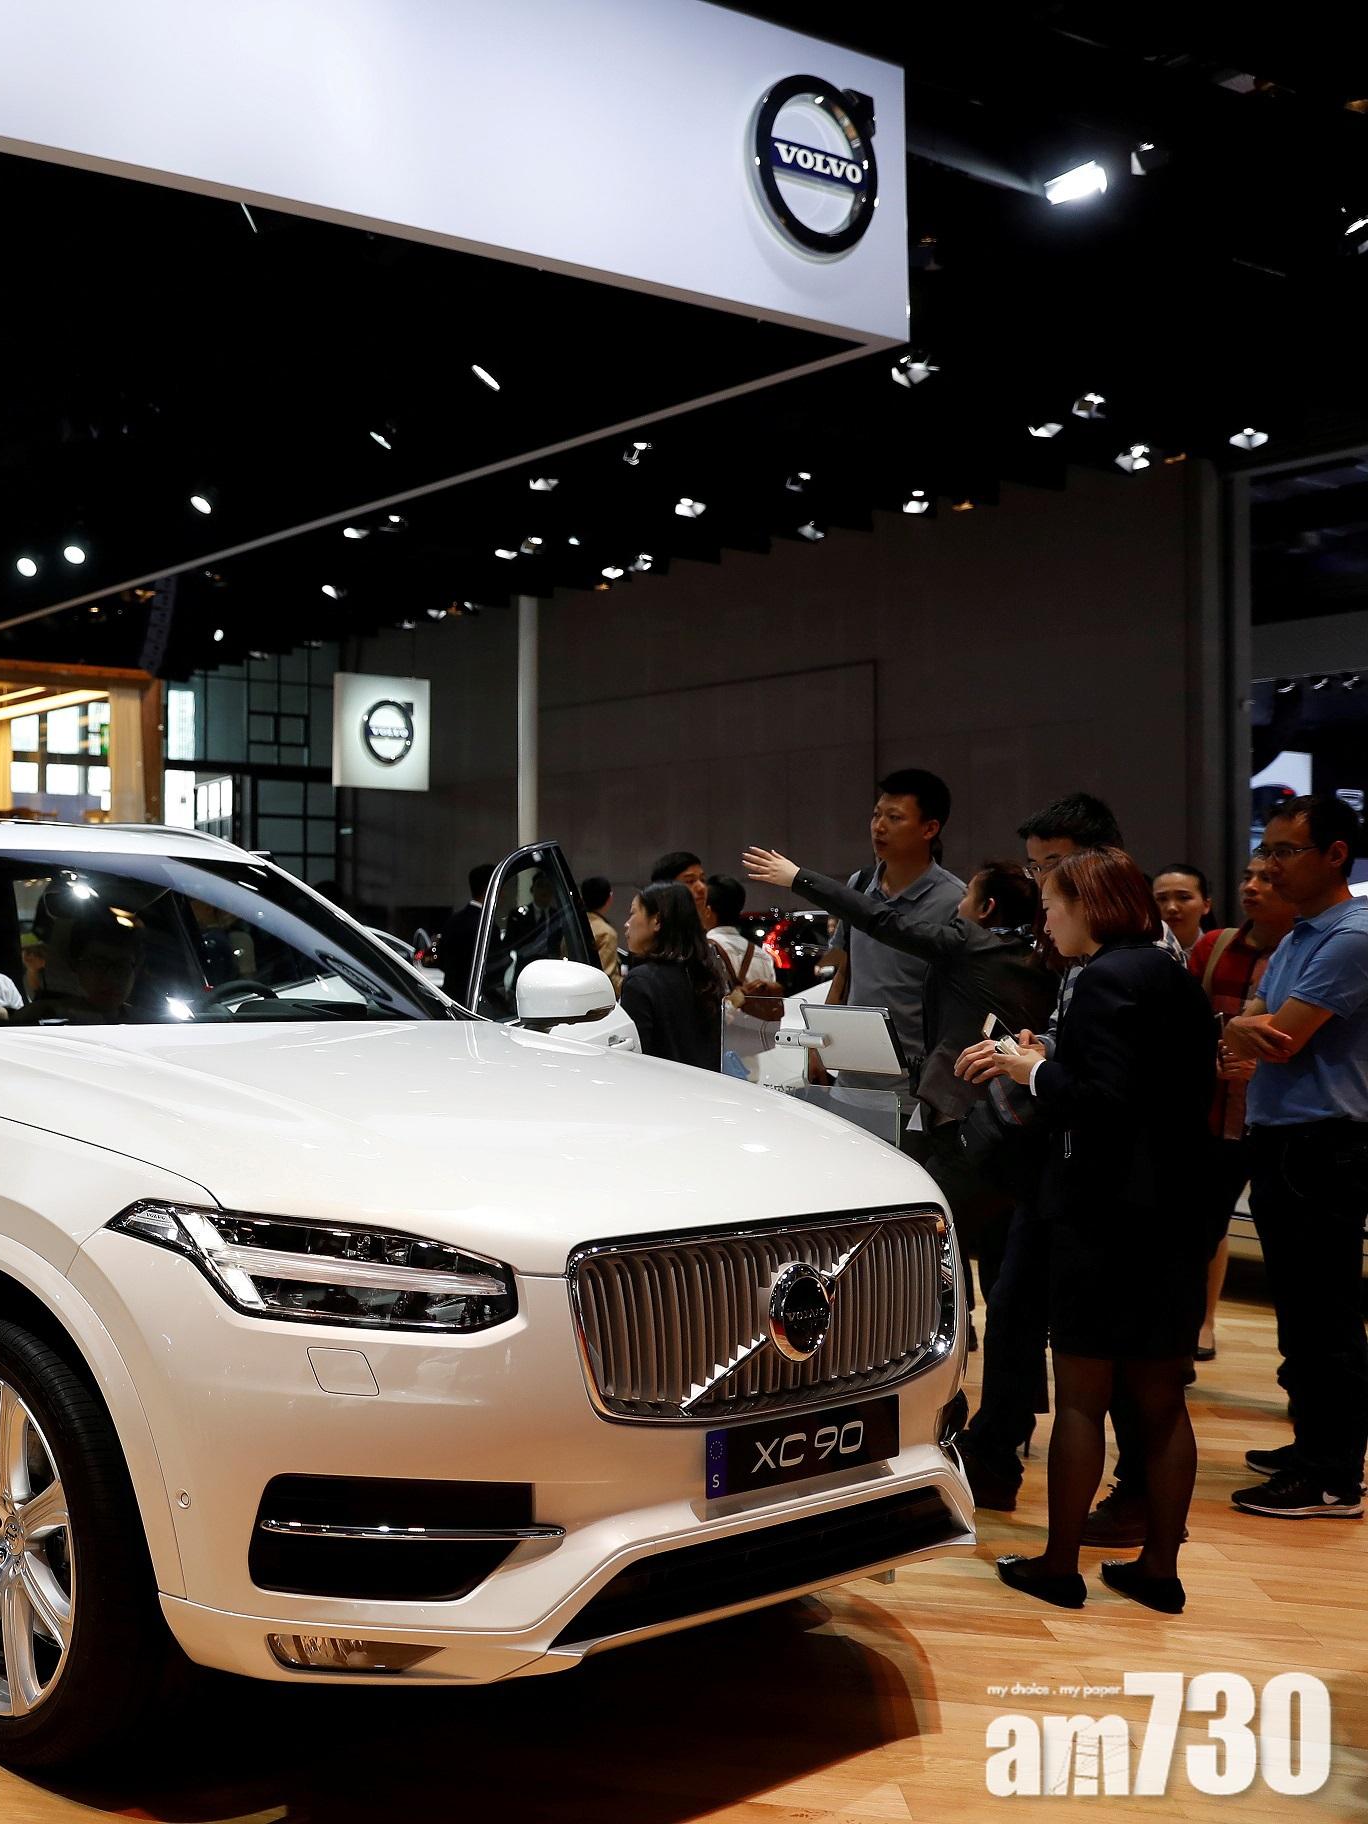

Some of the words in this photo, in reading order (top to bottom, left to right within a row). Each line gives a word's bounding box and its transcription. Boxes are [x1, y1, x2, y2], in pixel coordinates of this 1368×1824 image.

[774, 142, 862, 184] VOLVO
[370, 727, 409, 738] VOLVO
[751, 1432, 807, 1473] XC
[814, 1420, 864, 1460] 90
[712, 1474, 720, 1488] S
